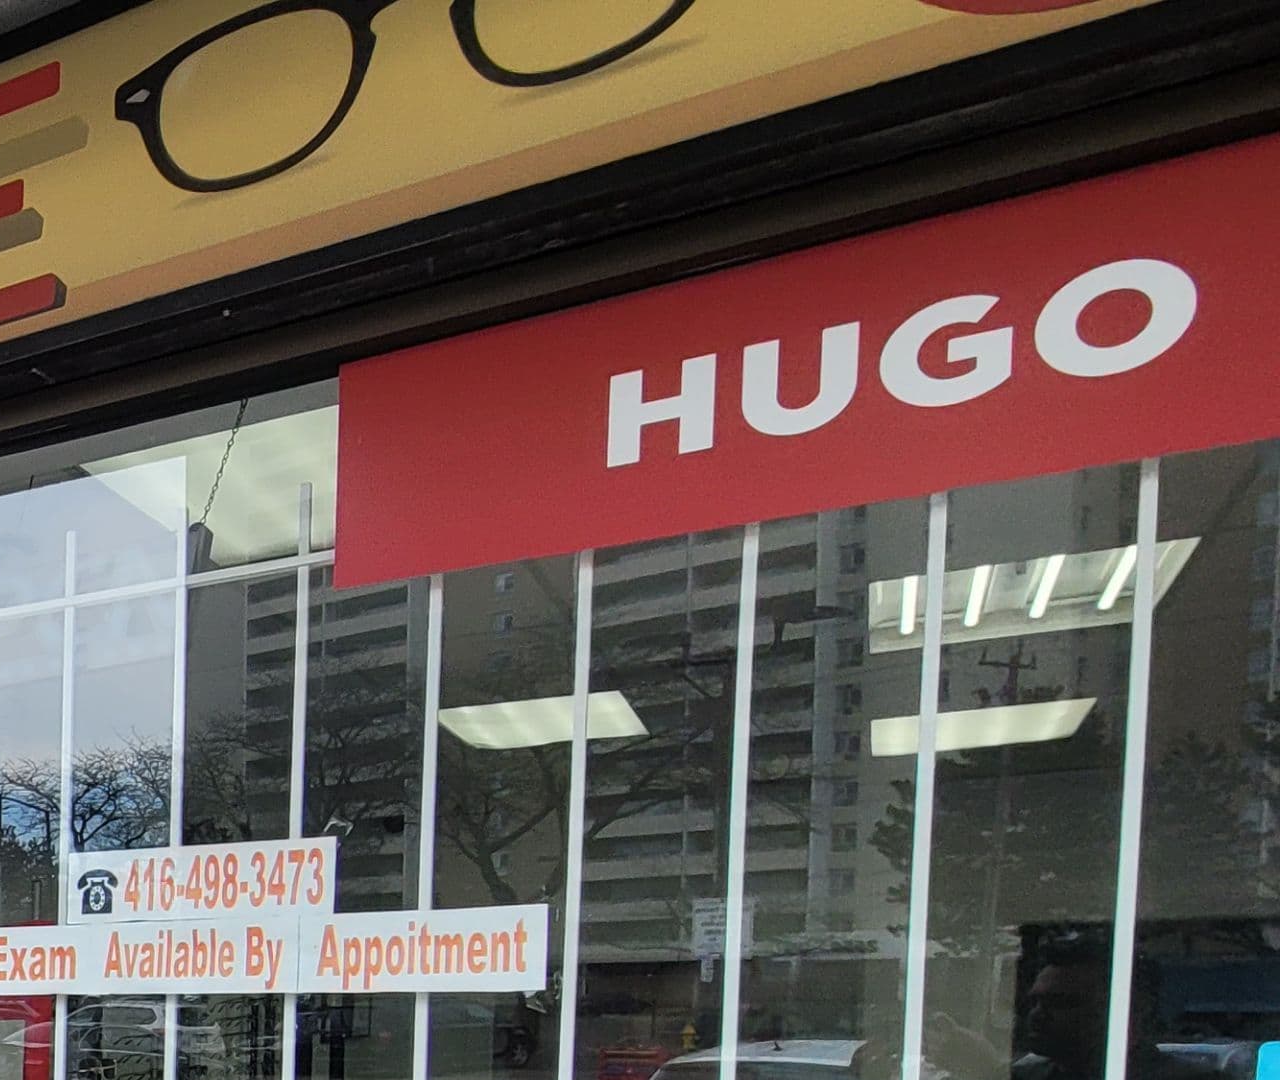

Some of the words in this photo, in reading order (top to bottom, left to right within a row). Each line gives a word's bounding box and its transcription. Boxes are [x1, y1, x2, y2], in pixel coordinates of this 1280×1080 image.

[607, 258, 1198, 469] HUGO
[124, 848, 325, 912] 416-498-3473
[104, 928, 235, 979] Available
[246, 926, 282, 988] By
[317, 917, 527, 990] Appoitment
